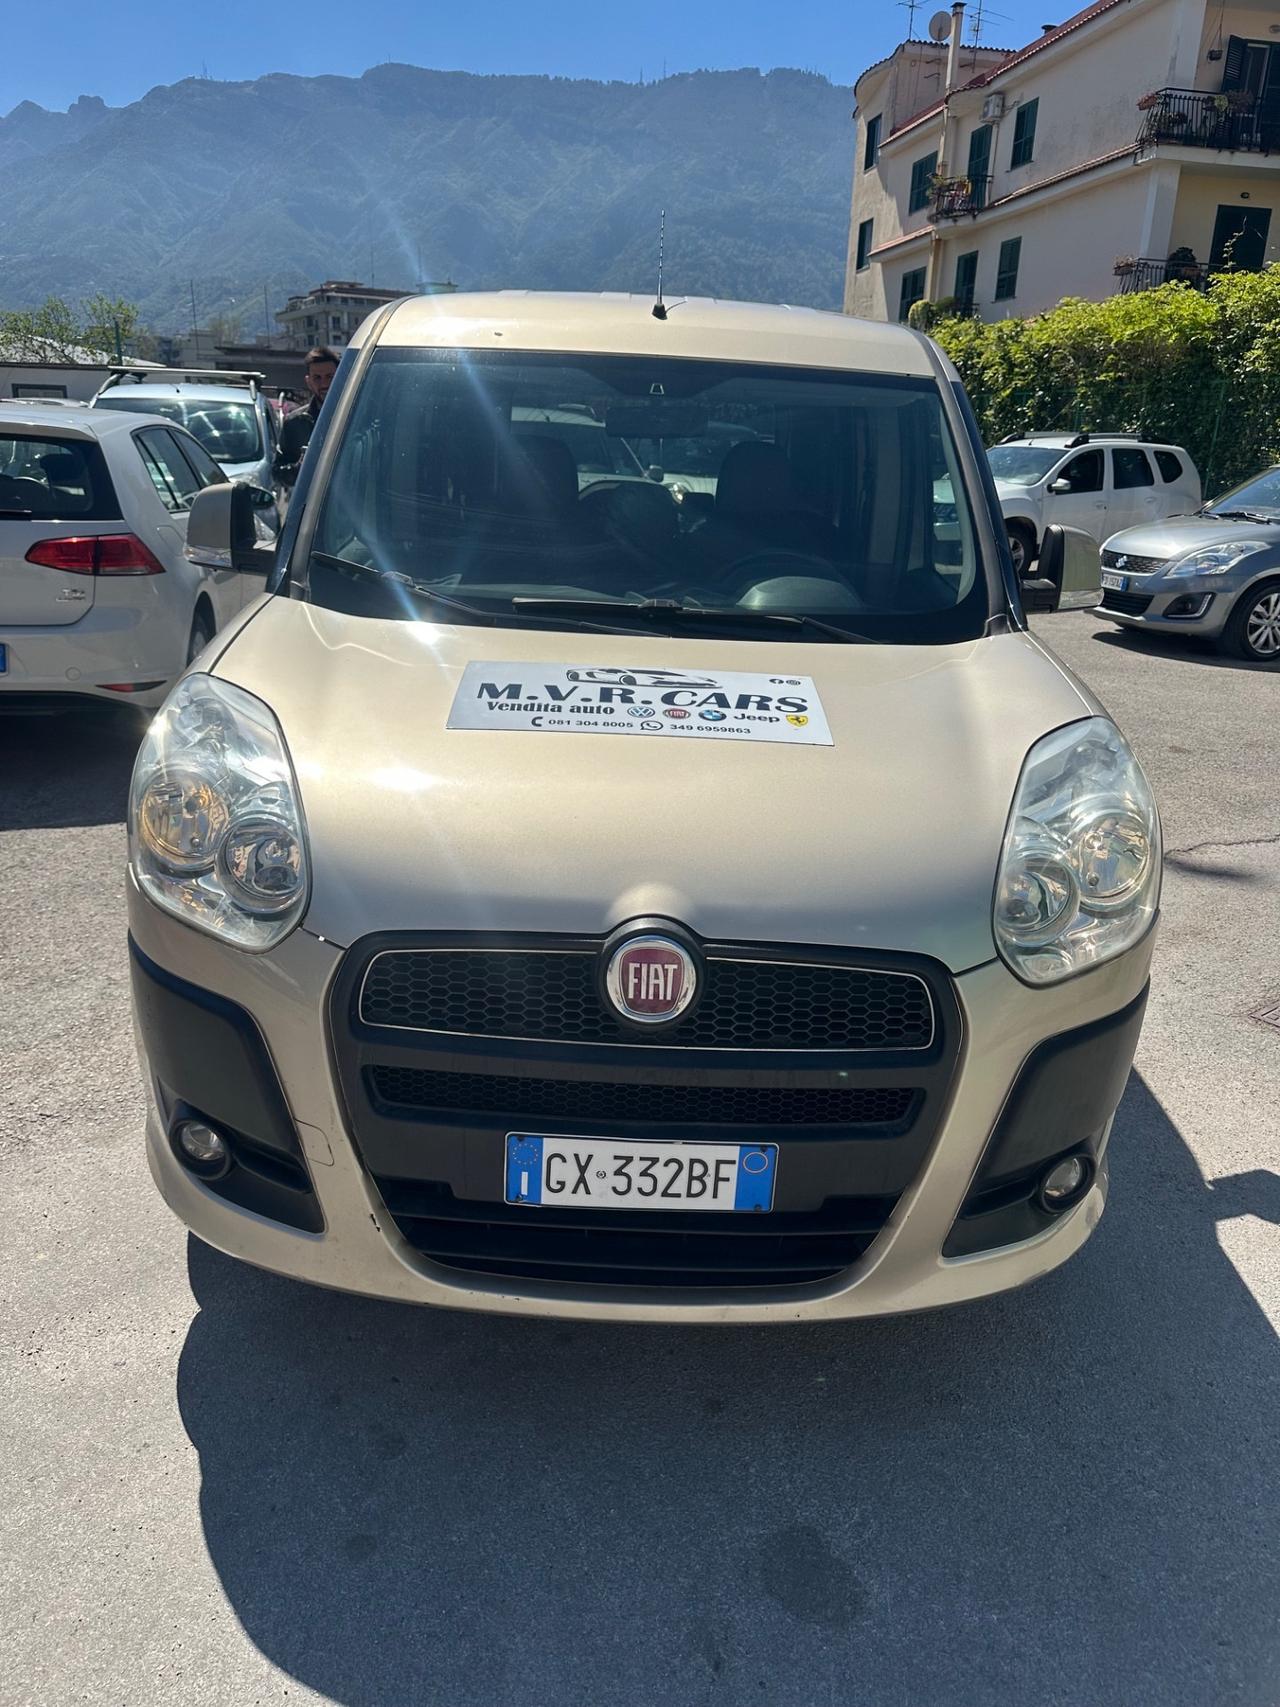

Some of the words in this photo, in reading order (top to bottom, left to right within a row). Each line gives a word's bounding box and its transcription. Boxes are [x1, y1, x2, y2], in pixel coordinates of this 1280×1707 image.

[487, 701, 562, 713] Vendita
[569, 704, 615, 715] auto
[733, 713, 781, 723] Jeep
[627, 962, 678, 1001] FIAT
[545, 1153, 594, 1195] GX
[611, 1155, 737, 1199] 332BF
